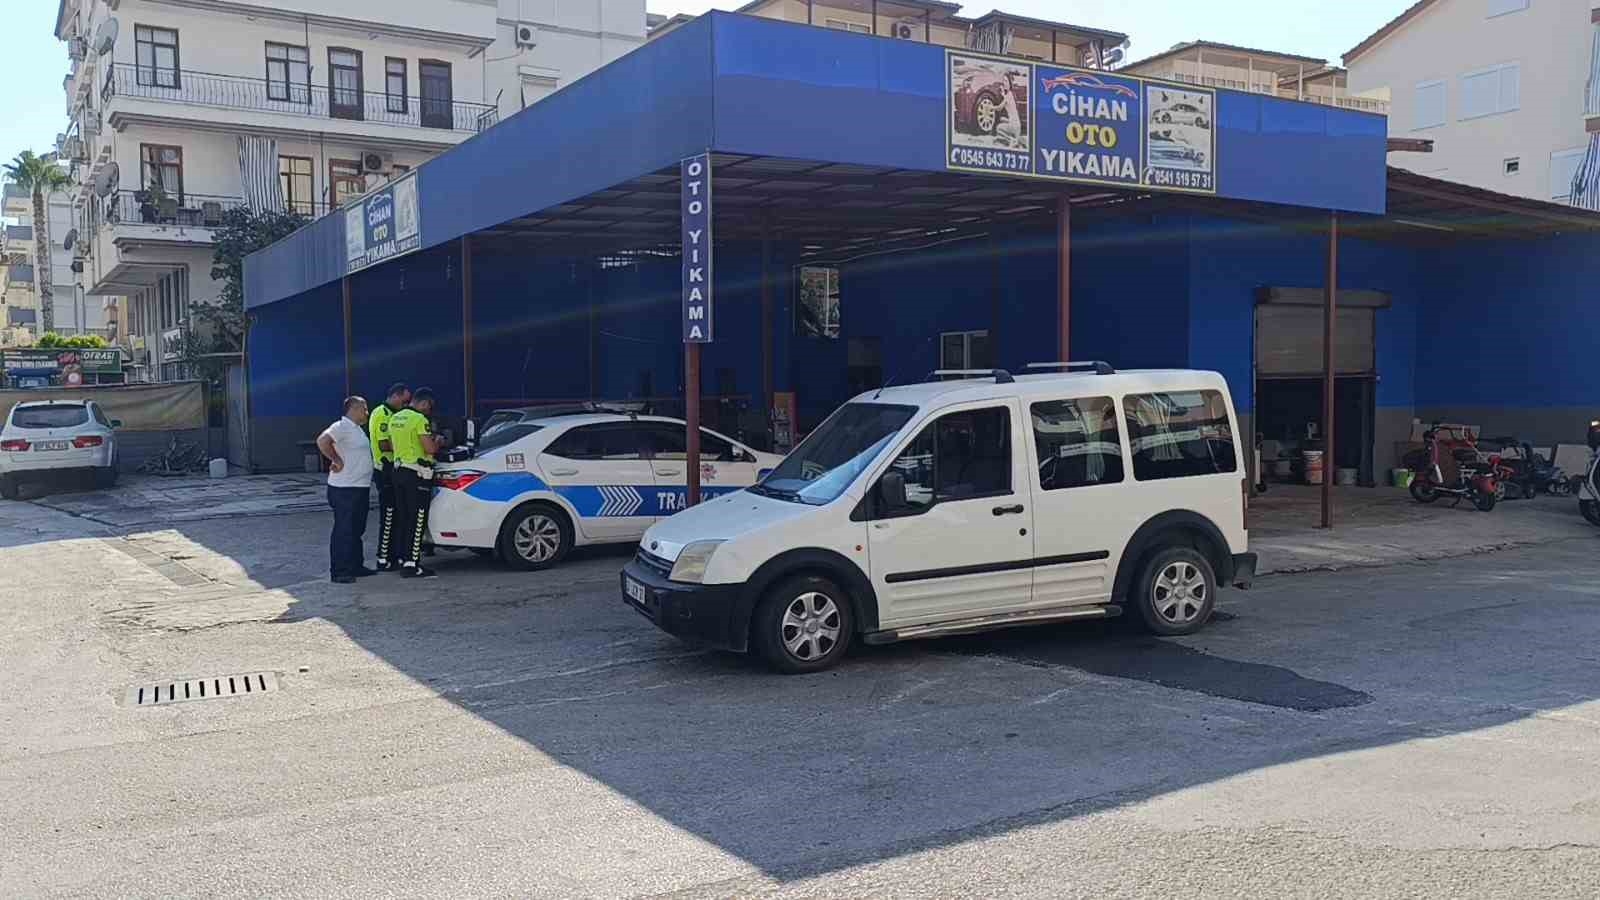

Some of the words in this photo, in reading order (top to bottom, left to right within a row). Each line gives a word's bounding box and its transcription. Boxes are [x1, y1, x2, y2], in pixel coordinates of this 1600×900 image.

[1052, 90, 1127, 121] CİHAN
[1066, 121, 1117, 148] OTO
[960, 149, 984, 166] 0545
[986, 151, 1003, 168] 643
[1005, 153, 1017, 169] 73
[1018, 155, 1030, 170] 77
[1040, 148, 1137, 179] YIKAMA
[688, 162, 702, 215] OTO
[366, 240, 396, 263] YIKAMA
[688, 229, 703, 339] YIKAMA
[656, 491, 709, 511] TRAK
